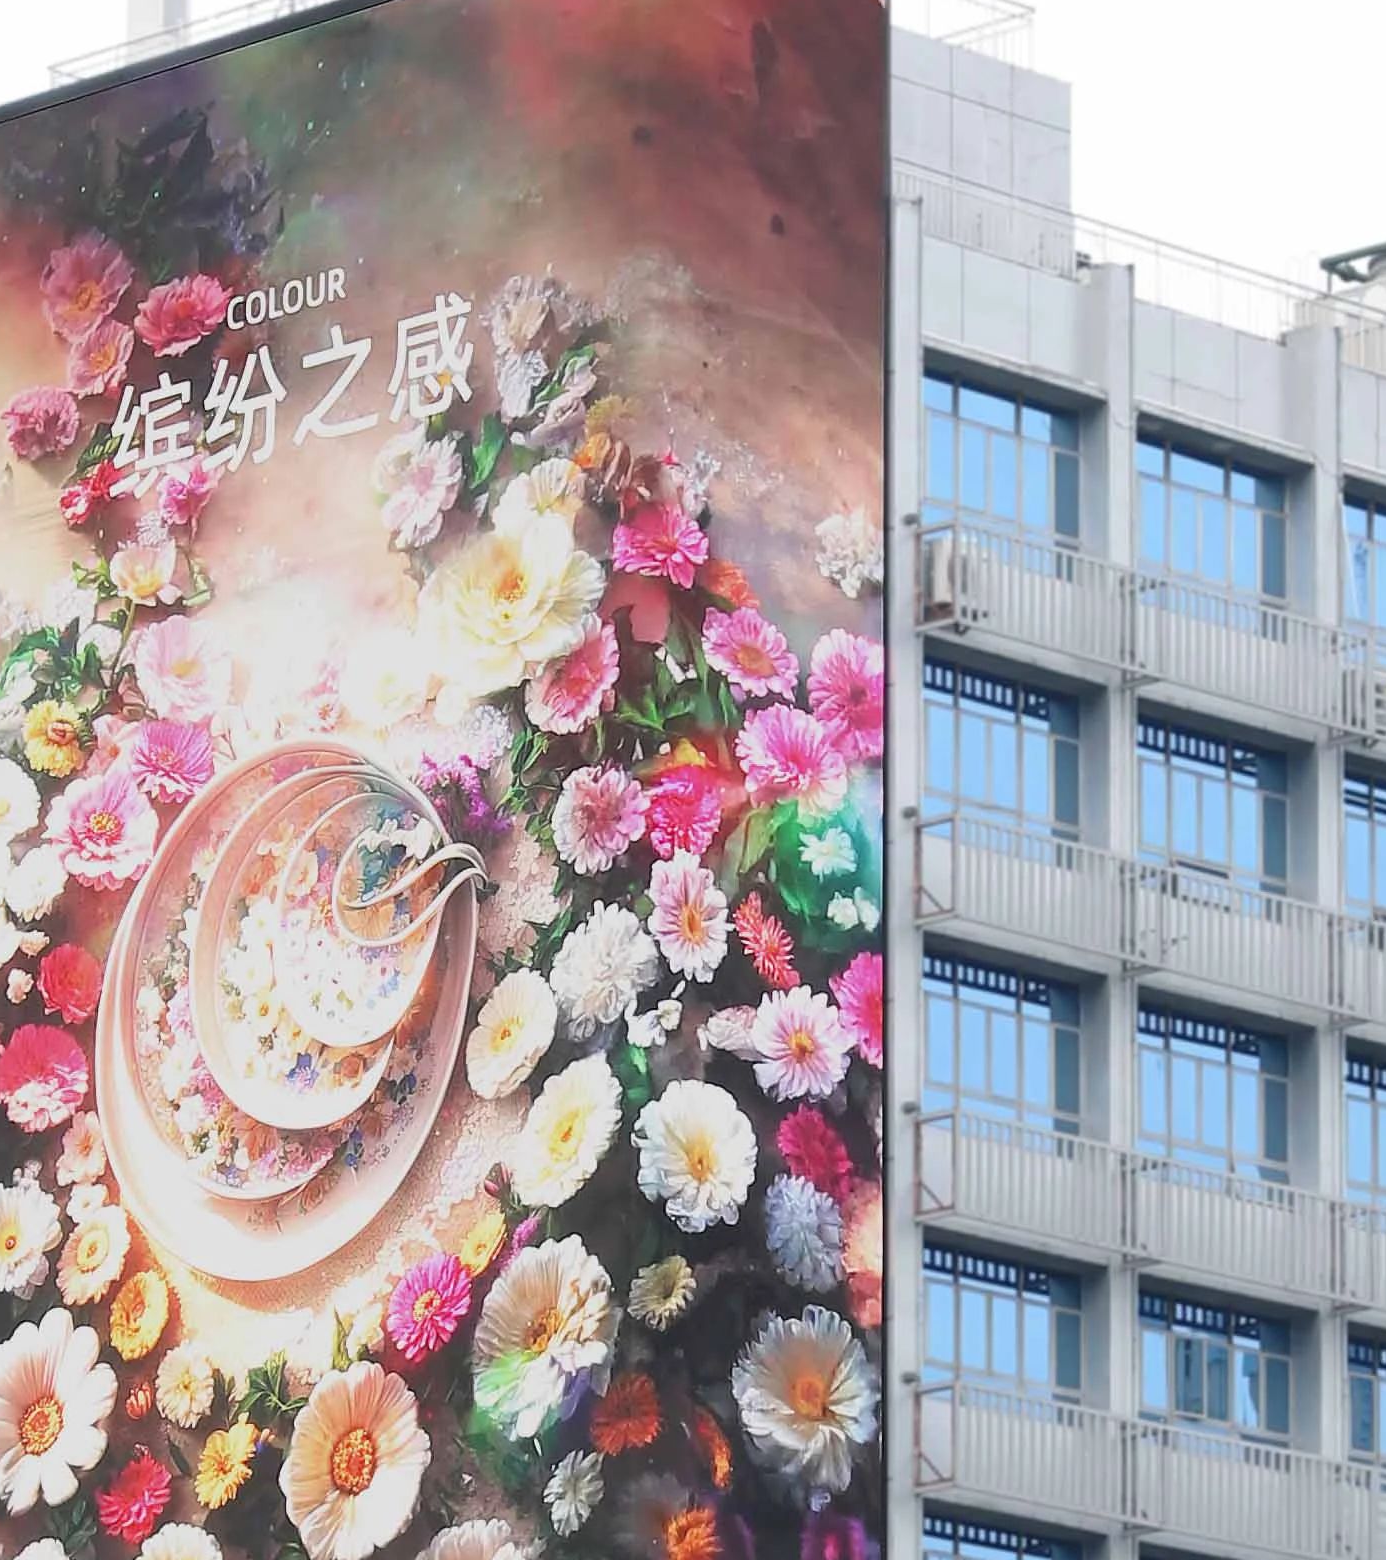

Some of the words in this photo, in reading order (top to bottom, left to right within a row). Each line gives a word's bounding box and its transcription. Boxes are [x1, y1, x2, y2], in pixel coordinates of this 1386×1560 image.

[225, 267, 347, 332] COLOUR
[108, 290, 476, 500] 缤纷之感
